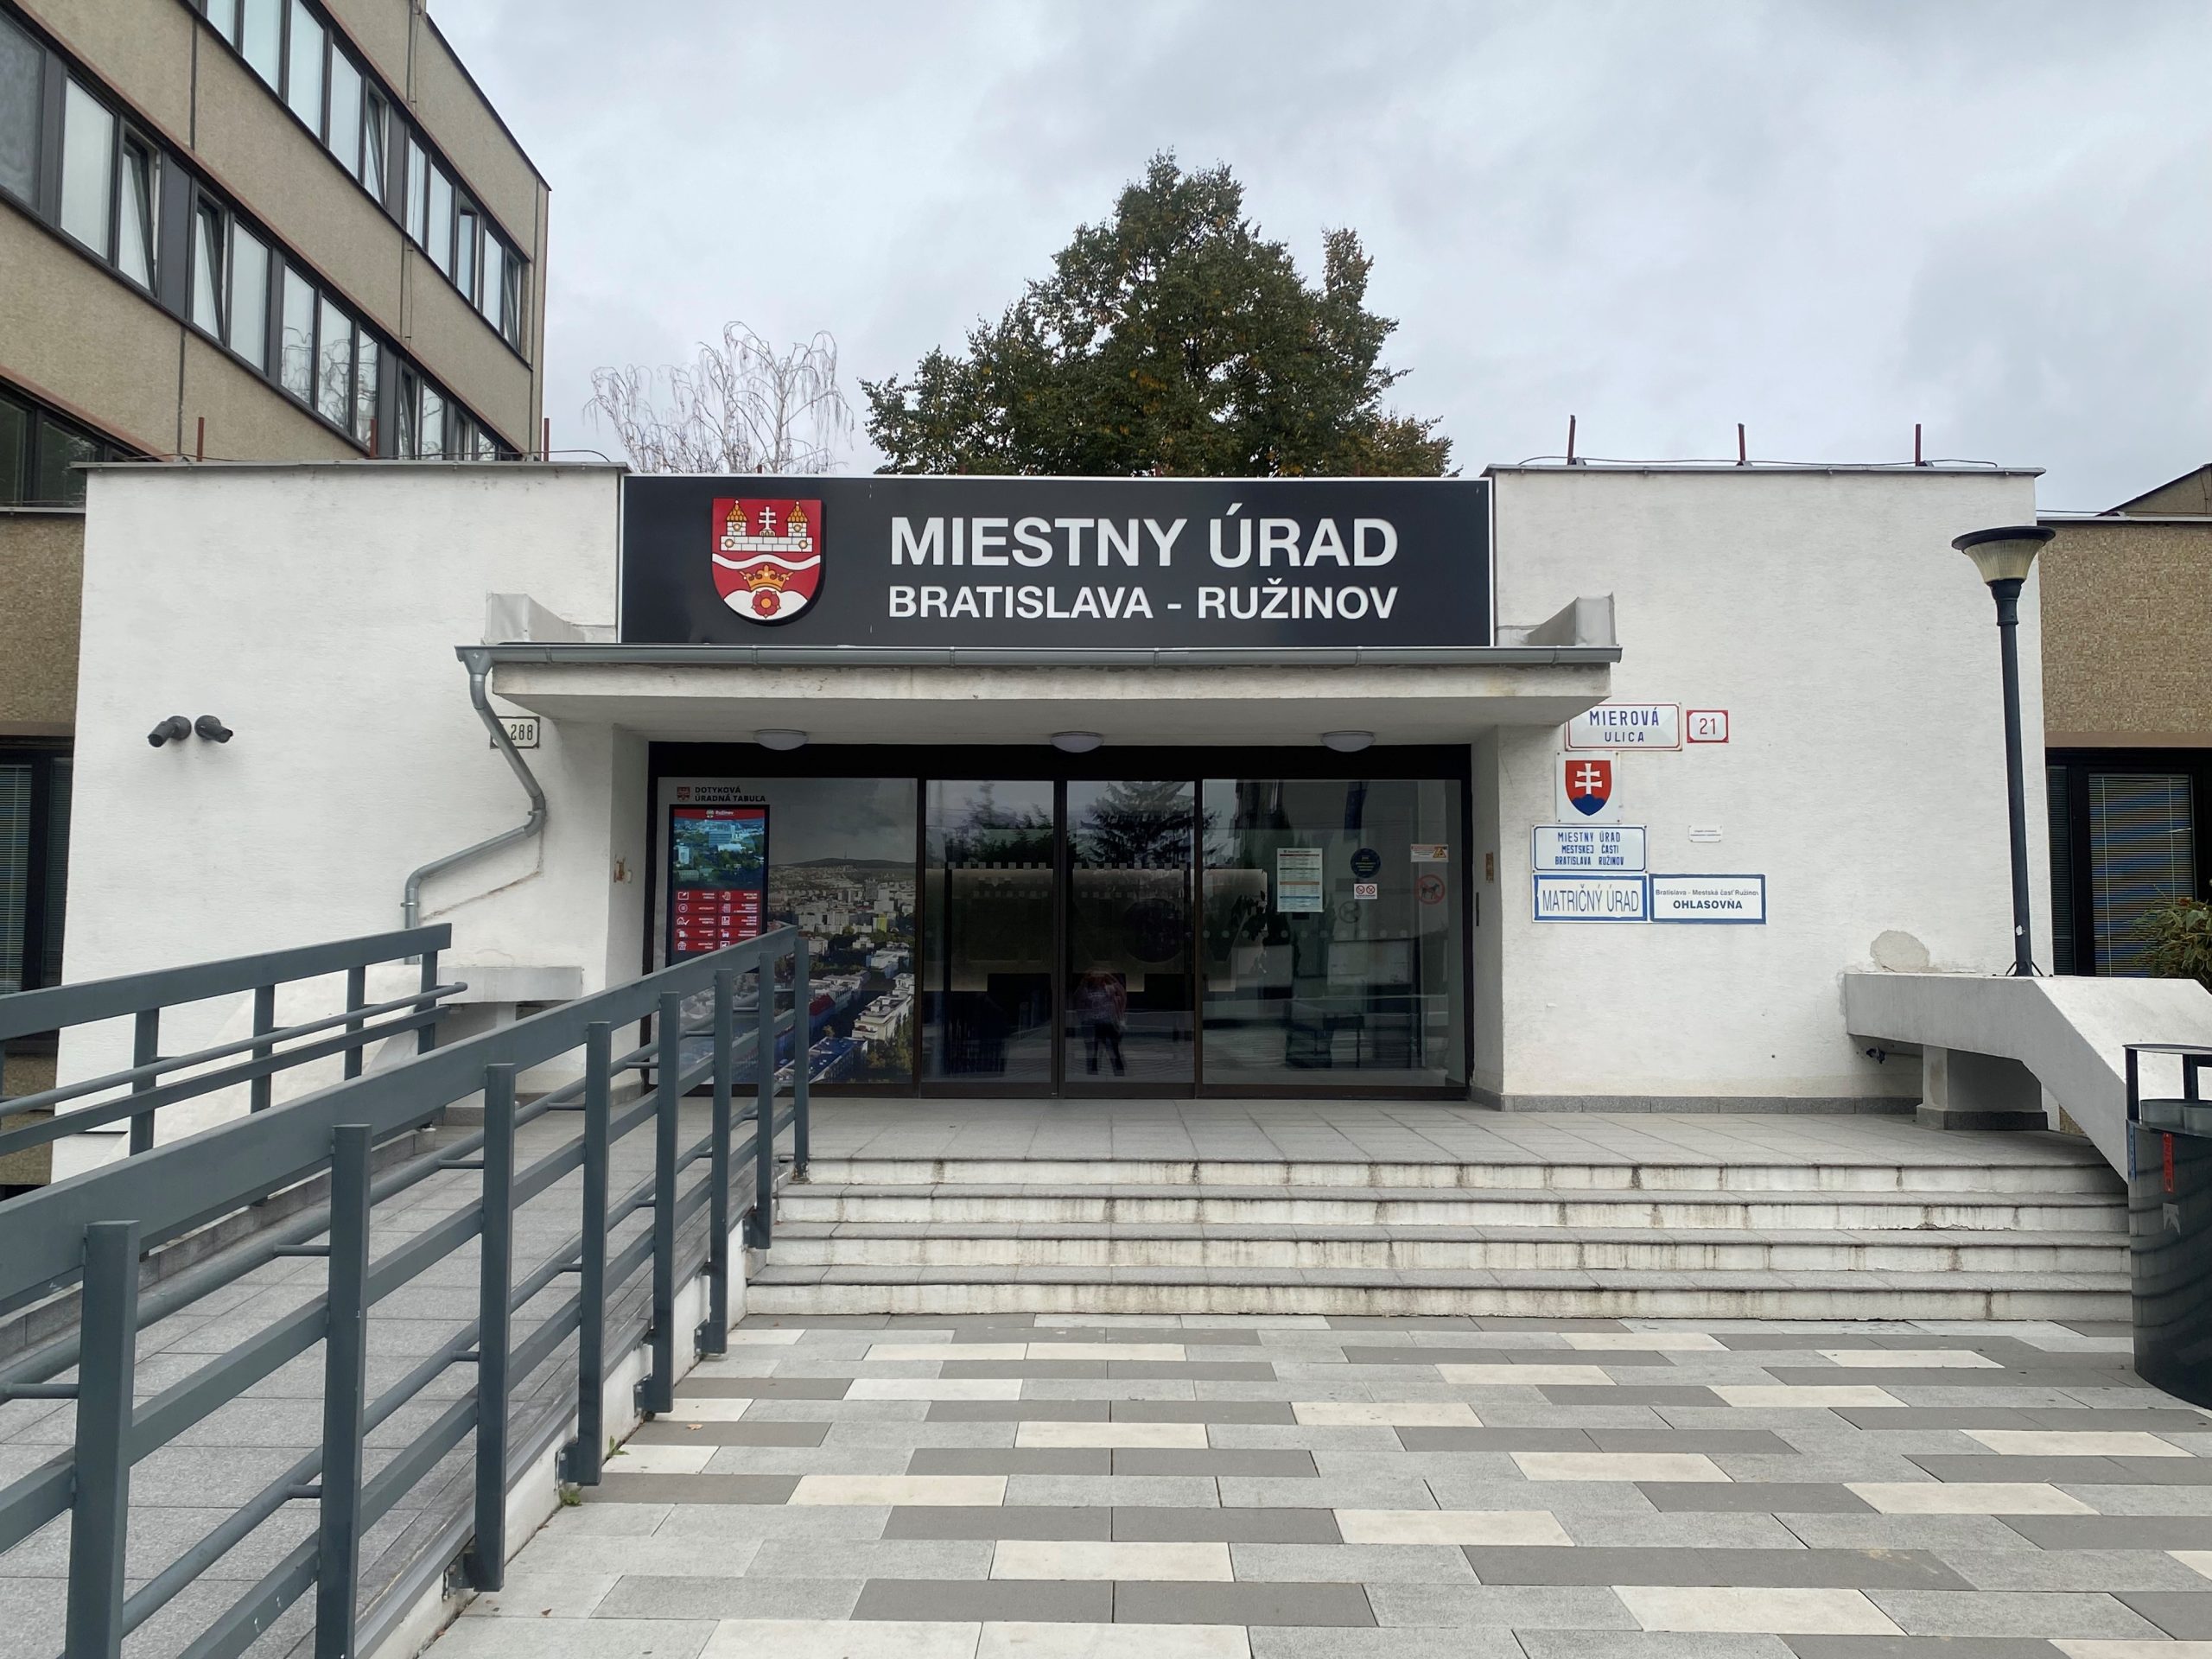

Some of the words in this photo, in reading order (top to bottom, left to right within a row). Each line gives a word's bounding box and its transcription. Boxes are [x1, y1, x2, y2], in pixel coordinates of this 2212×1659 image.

[890, 517, 1187, 567] MIESTNY
[1210, 503, 1399, 567] ÚRAD
[888, 585, 1154, 619] BRATISLAVA
[1198, 578, 1399, 619] RUŽINOV
[1589, 707, 1659, 726] MIEROVÁ
[1699, 718, 1716, 734] 21
[1605, 731, 1644, 742] ULICA
[695, 793, 730, 802] ÚRADNÁ
[1557, 831, 1593, 842] MIESTNY
[1599, 830, 1621, 842] ÚRAD
[1561, 845, 1594, 854] MESTSKEJ
[1601, 844, 1618, 854] ČASTI
[1555, 856, 1591, 865] BRATISLAVA
[1599, 855, 1624, 866] RUŽINOV
[1542, 883, 1603, 912] MATRIČNÝ
[1606, 884, 1638, 912] ÚRAD
[1673, 899, 1743, 909] OHLASOVŇA
